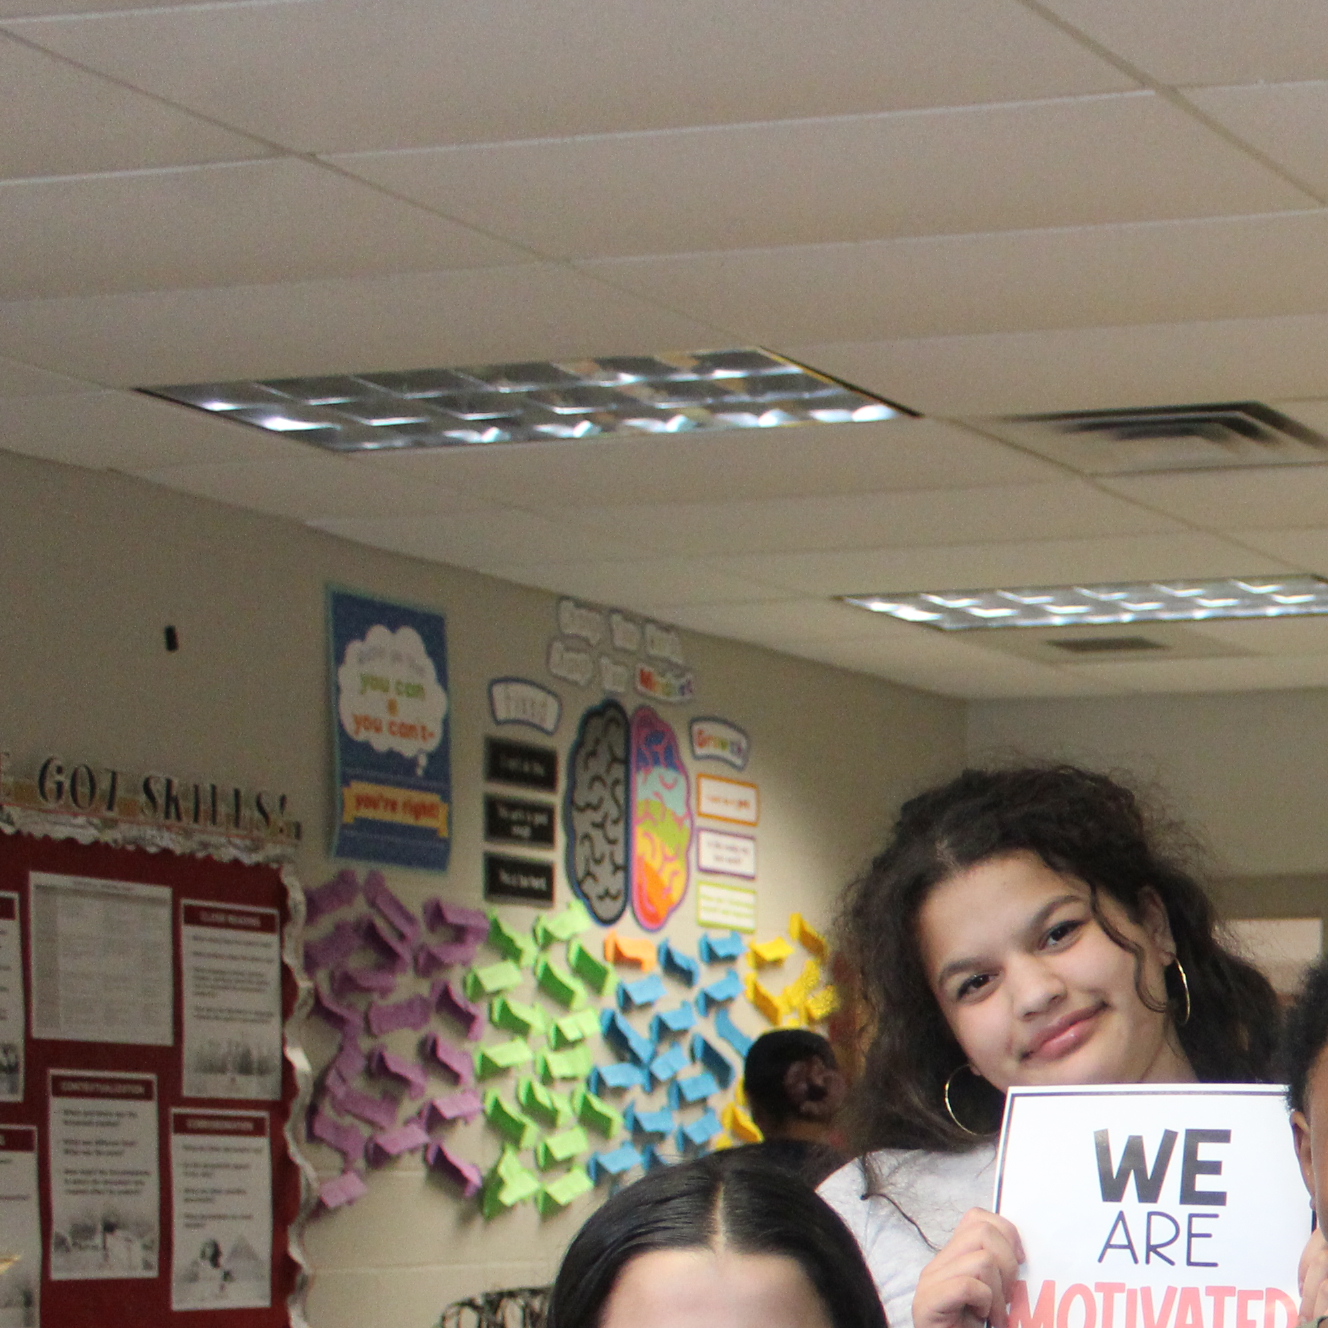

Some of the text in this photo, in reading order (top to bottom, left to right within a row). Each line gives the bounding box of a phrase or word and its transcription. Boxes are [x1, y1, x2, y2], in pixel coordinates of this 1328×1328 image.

[38, 755, 117, 812] GOT
[1094, 1128, 1231, 1206] WE
[1098, 1211, 1219, 1267] ARE
